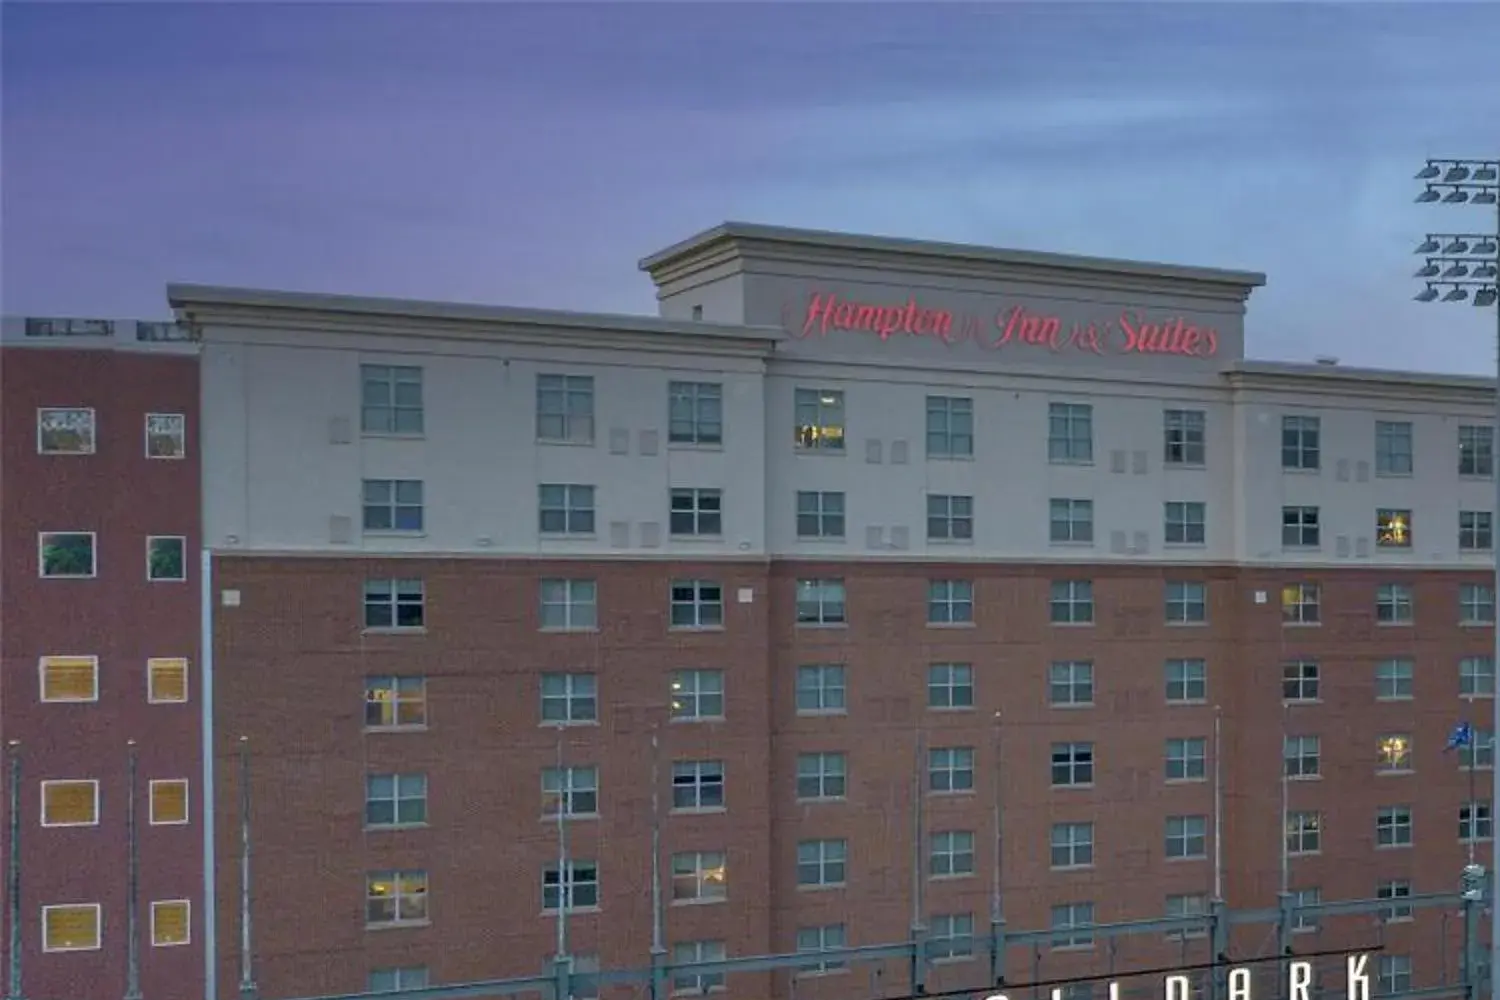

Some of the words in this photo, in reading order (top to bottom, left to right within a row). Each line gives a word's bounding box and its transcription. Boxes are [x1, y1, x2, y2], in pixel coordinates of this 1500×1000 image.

[793, 292, 957, 342] Hampton
[994, 304, 1066, 349] Inn
[1112, 308, 1218, 356] Suites
